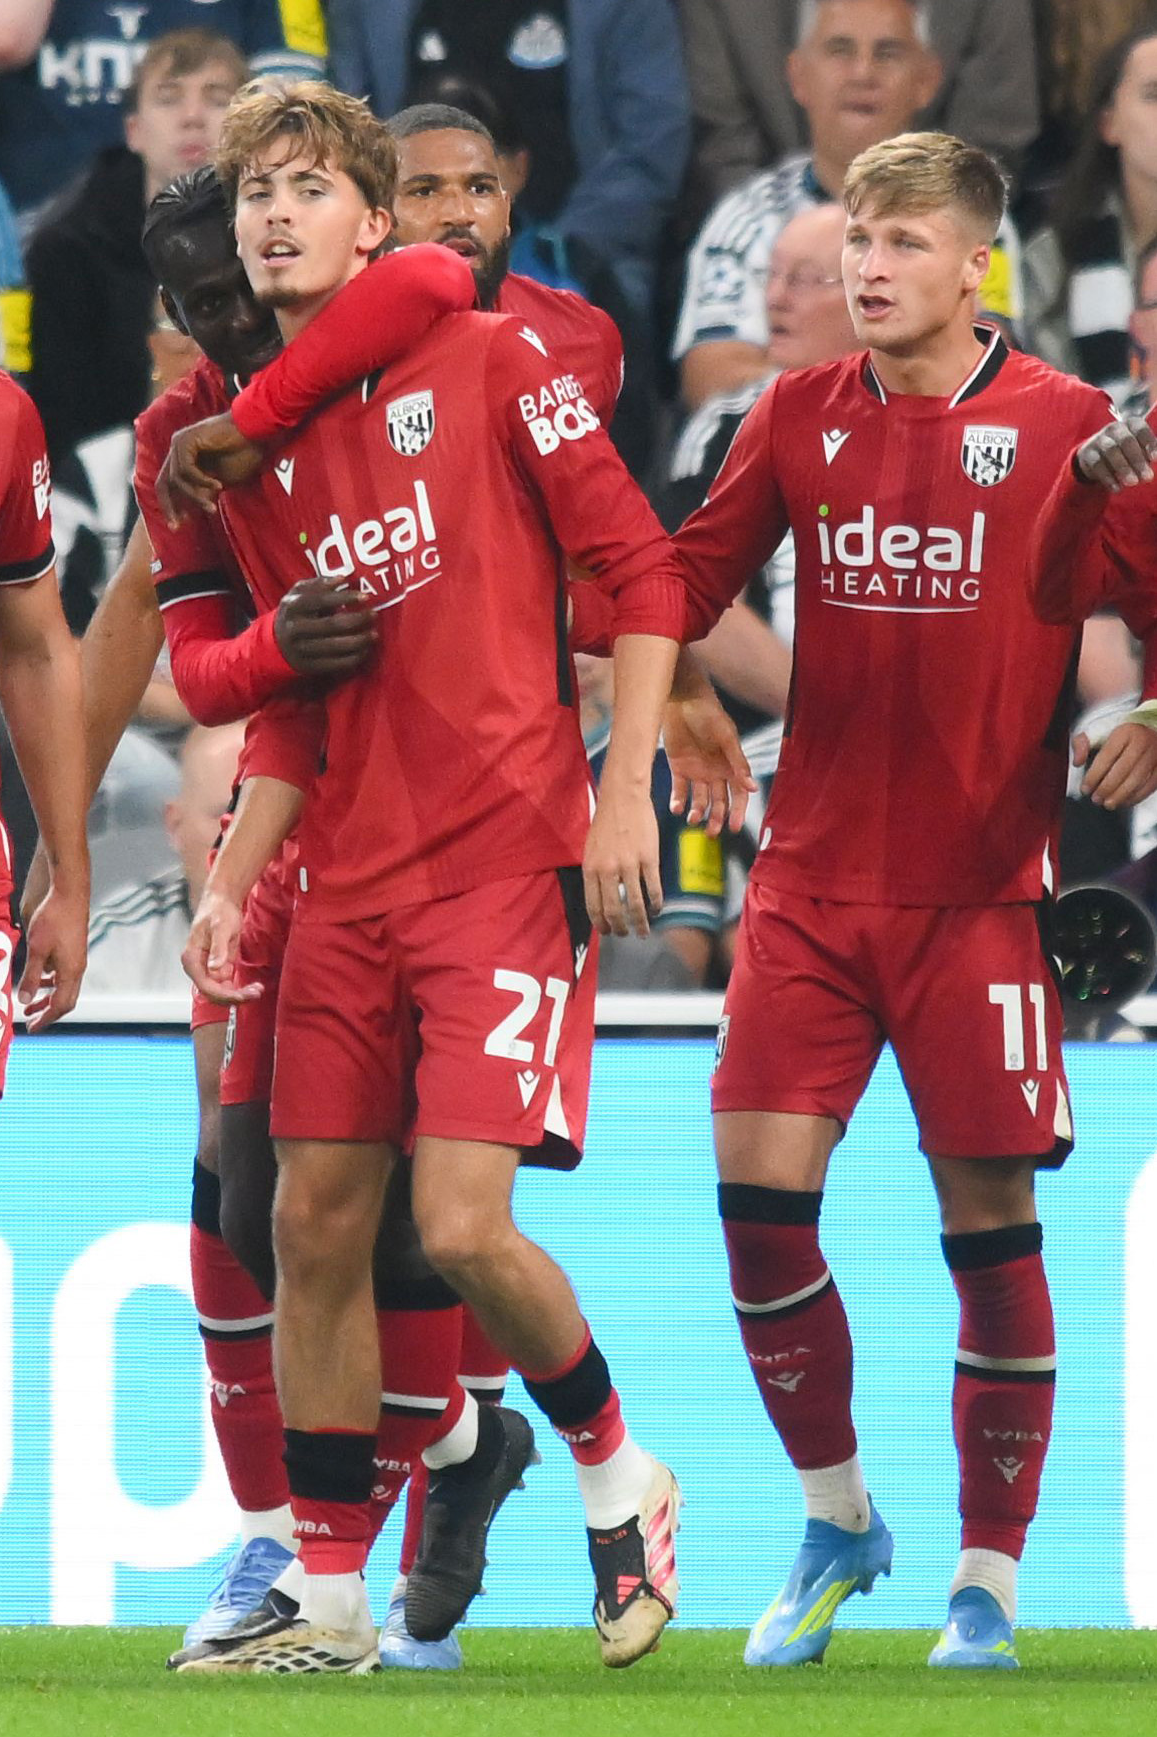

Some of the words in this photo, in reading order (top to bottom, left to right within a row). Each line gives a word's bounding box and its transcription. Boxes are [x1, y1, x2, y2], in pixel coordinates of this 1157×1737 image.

[967, 433, 1014, 446] ALBION
[299, 479, 437, 578] ideal
[817, 504, 986, 573] ideal
[335, 546, 441, 595] ATING
[821, 570, 980, 601] HEATING
[484, 968, 570, 1067] 21
[988, 982, 1048, 1071] 11
